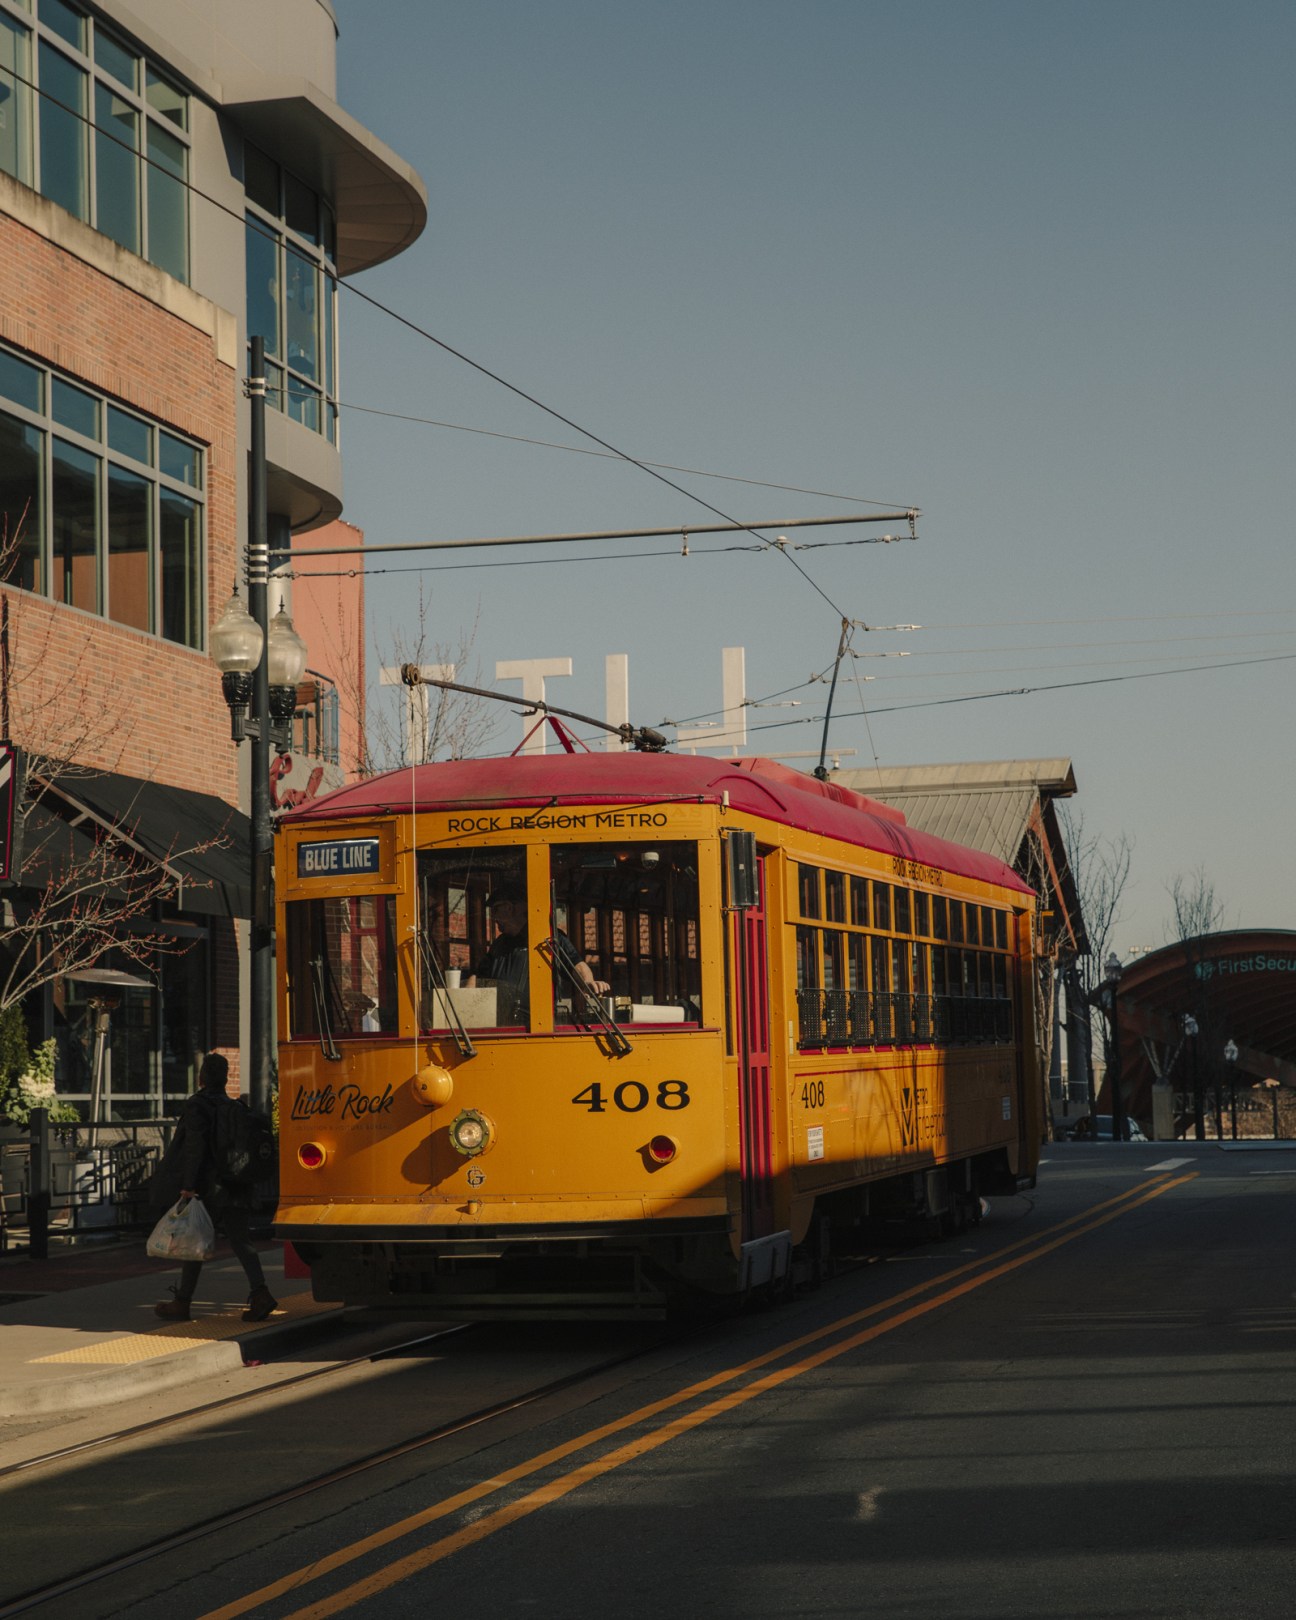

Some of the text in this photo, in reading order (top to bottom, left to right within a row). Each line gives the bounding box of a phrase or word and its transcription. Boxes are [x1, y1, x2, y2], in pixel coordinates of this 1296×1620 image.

[448, 813, 668, 833] ROCK REGION METRO
[305, 845, 372, 871] BLUE LINE
[291, 1083, 394, 1120] Little Rock
[571, 1080, 691, 1113] 408
[801, 1080, 825, 1109] 408
